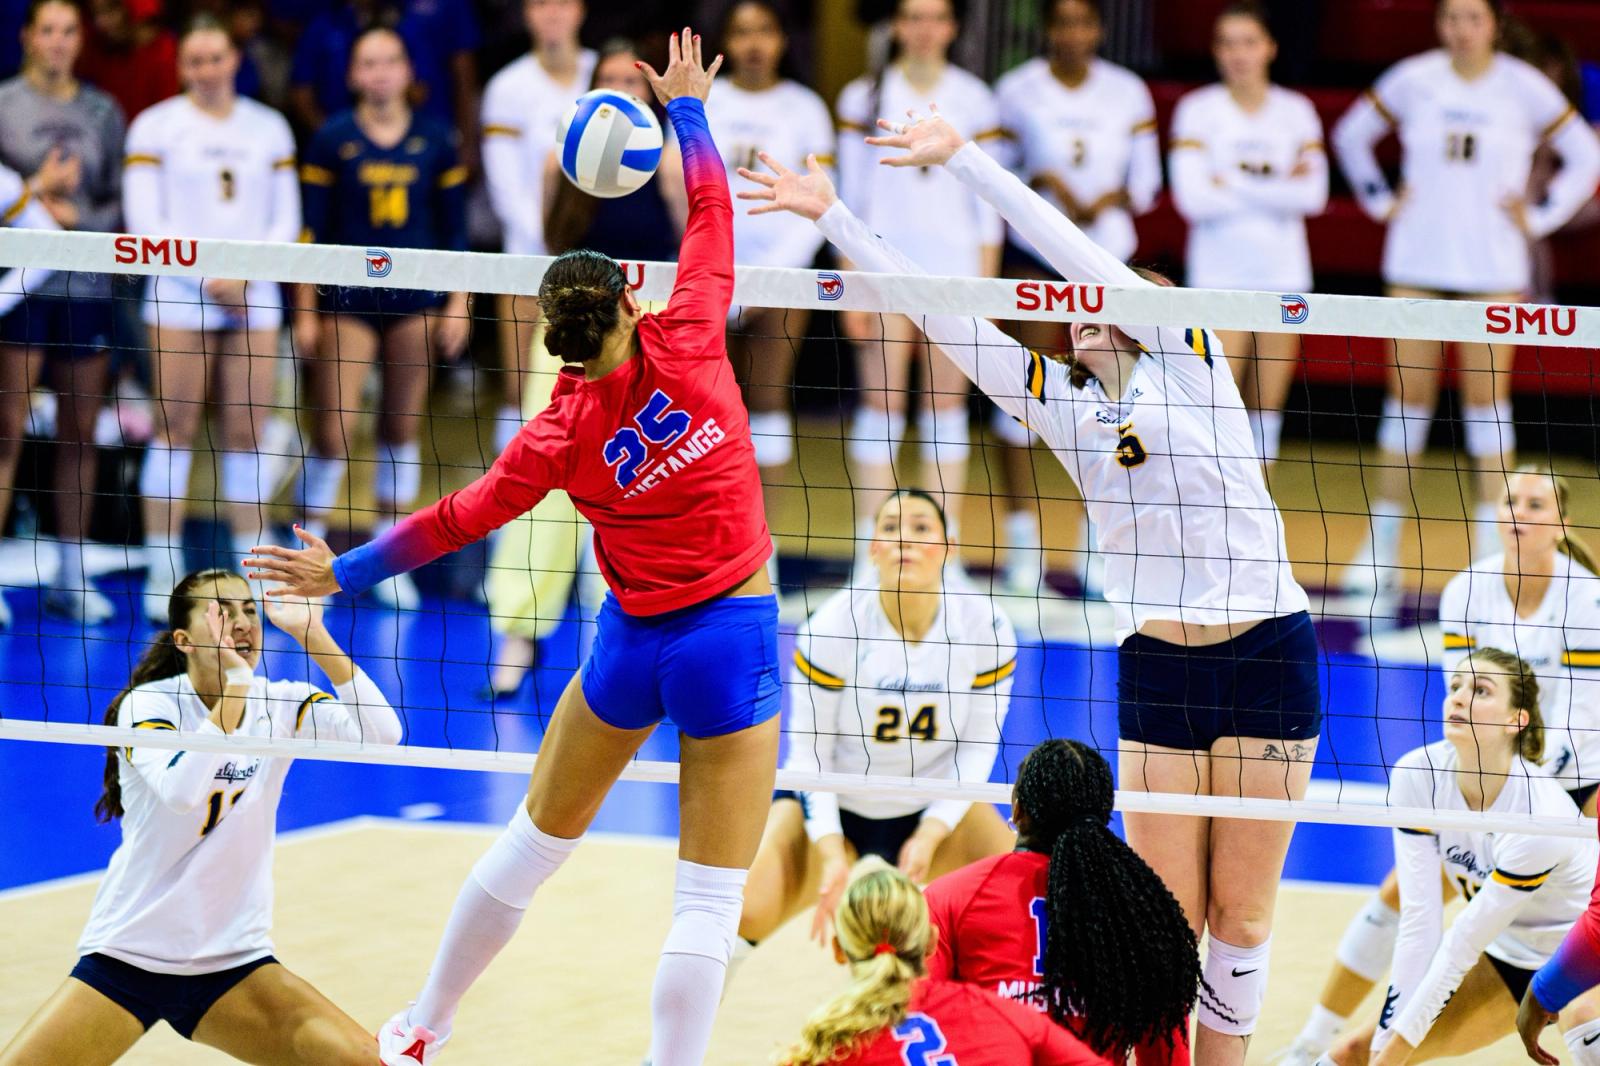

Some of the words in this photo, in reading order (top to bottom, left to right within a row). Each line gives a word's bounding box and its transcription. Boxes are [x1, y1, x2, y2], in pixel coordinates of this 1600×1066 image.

[115, 235, 198, 267] SMU
[1016, 281, 1105, 313] SMU
[1485, 304, 1577, 336] SMU
[602, 388, 693, 490] 25
[874, 704, 938, 743] 24
[890, 1009, 960, 1066] 2
